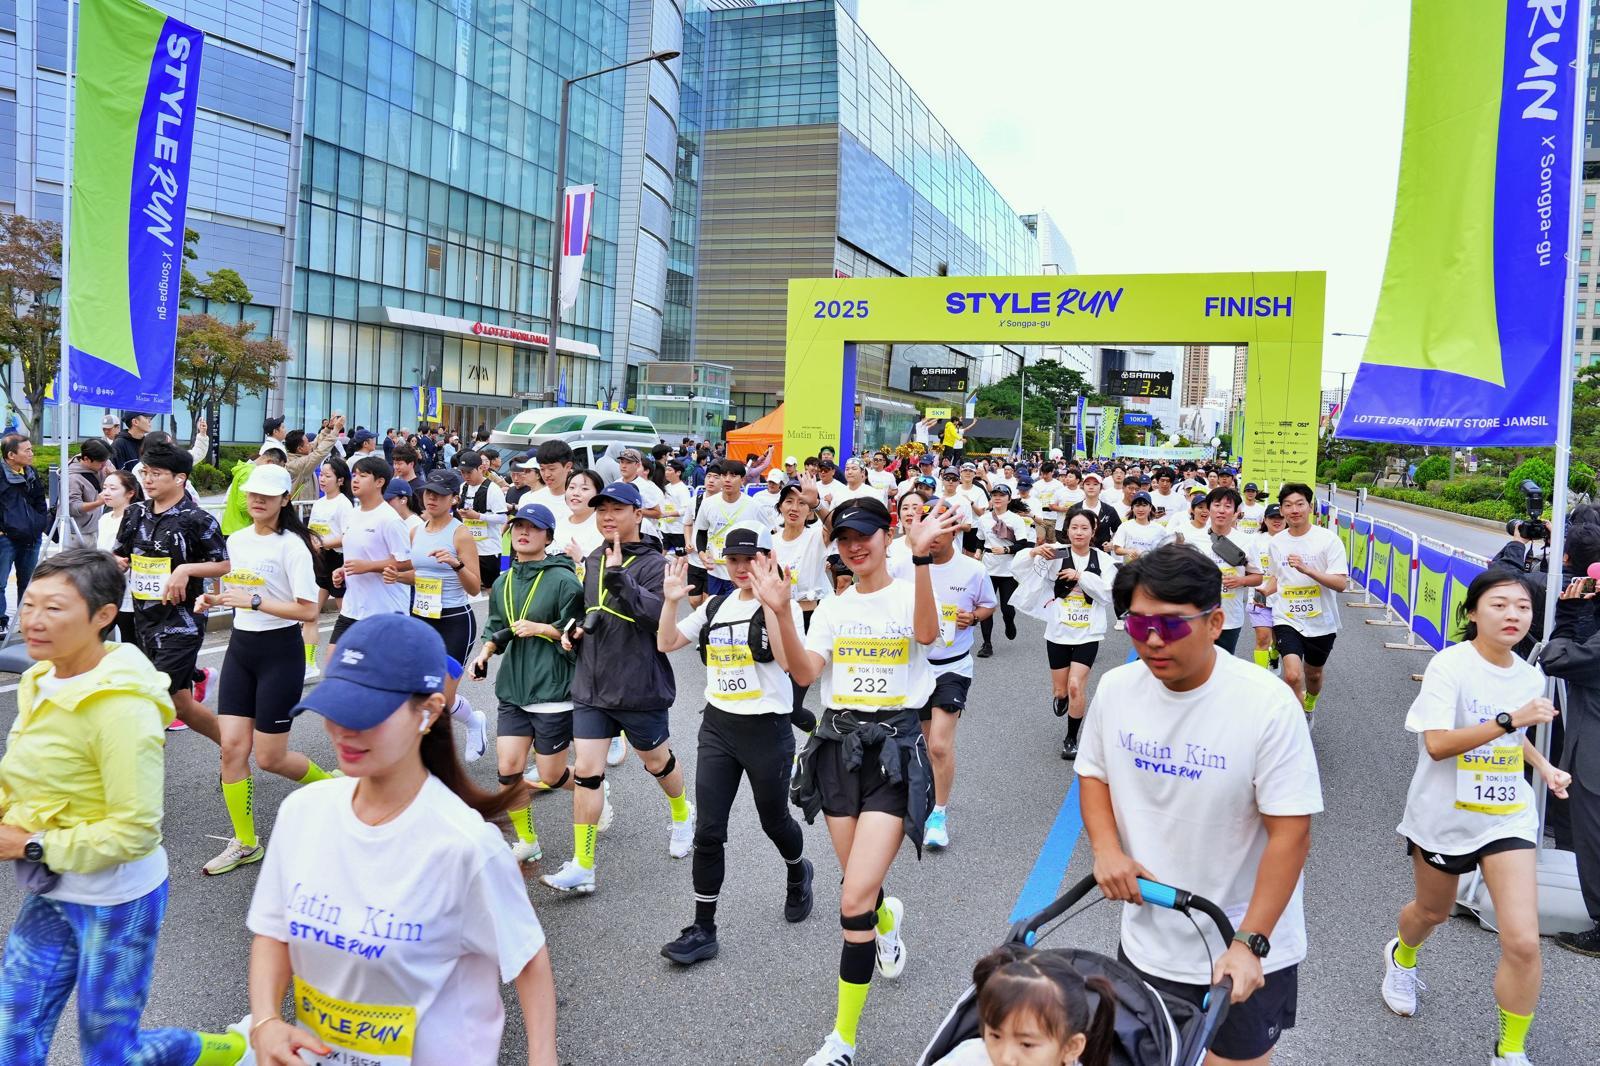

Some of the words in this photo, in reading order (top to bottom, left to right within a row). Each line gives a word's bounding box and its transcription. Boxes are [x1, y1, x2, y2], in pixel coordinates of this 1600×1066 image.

[154, 33, 191, 165] STYLE
[143, 163, 178, 248] RUN
[1537, 152, 1556, 268] Songpa-gu
[158, 261, 172, 321] Songpa-gu
[814, 300, 869, 319] 2025
[945, 292, 1051, 315] STYLE
[1056, 287, 1124, 318] RUN
[1204, 296, 1292, 318] FINISH
[1006, 319, 1051, 328] Songpa-gu
[483, 325, 509, 338] LOTTE
[509, 330, 533, 343] WORLD
[533, 334, 550, 346] MAL
[1129, 372, 1161, 380] SAMIK
[1353, 414, 1387, 426] LOTTE
[1387, 416, 1461, 428] DEPARTMENT
[1463, 417, 1500, 428] STORE
[1502, 416, 1549, 427] JAMSIL
[787, 429, 812, 440] Matin
[818, 430, 836, 440] Kim
[1068, 613, 1089, 621] 1046
[1289, 603, 1314, 613] 2503
[711, 637, 733, 645] STYLE
[838, 647, 877, 656] STYLE
[879, 647, 904, 659] RUN
[717, 677, 747, 692] 1060
[852, 677, 888, 694] 232
[1115, 729, 1172, 759] Matin
[1184, 743, 1227, 770] Kim
[1463, 754, 1506, 765] STYLE
[1134, 758, 1177, 776] STYLE
[1178, 766, 1203, 781] RUN
[1474, 785, 1516, 801] 1433
[358, 905, 423, 942] Kim
[289, 921, 346, 950] STYLE
[347, 938, 386, 960] RUN
[355, 1021, 403, 1045] RUN
